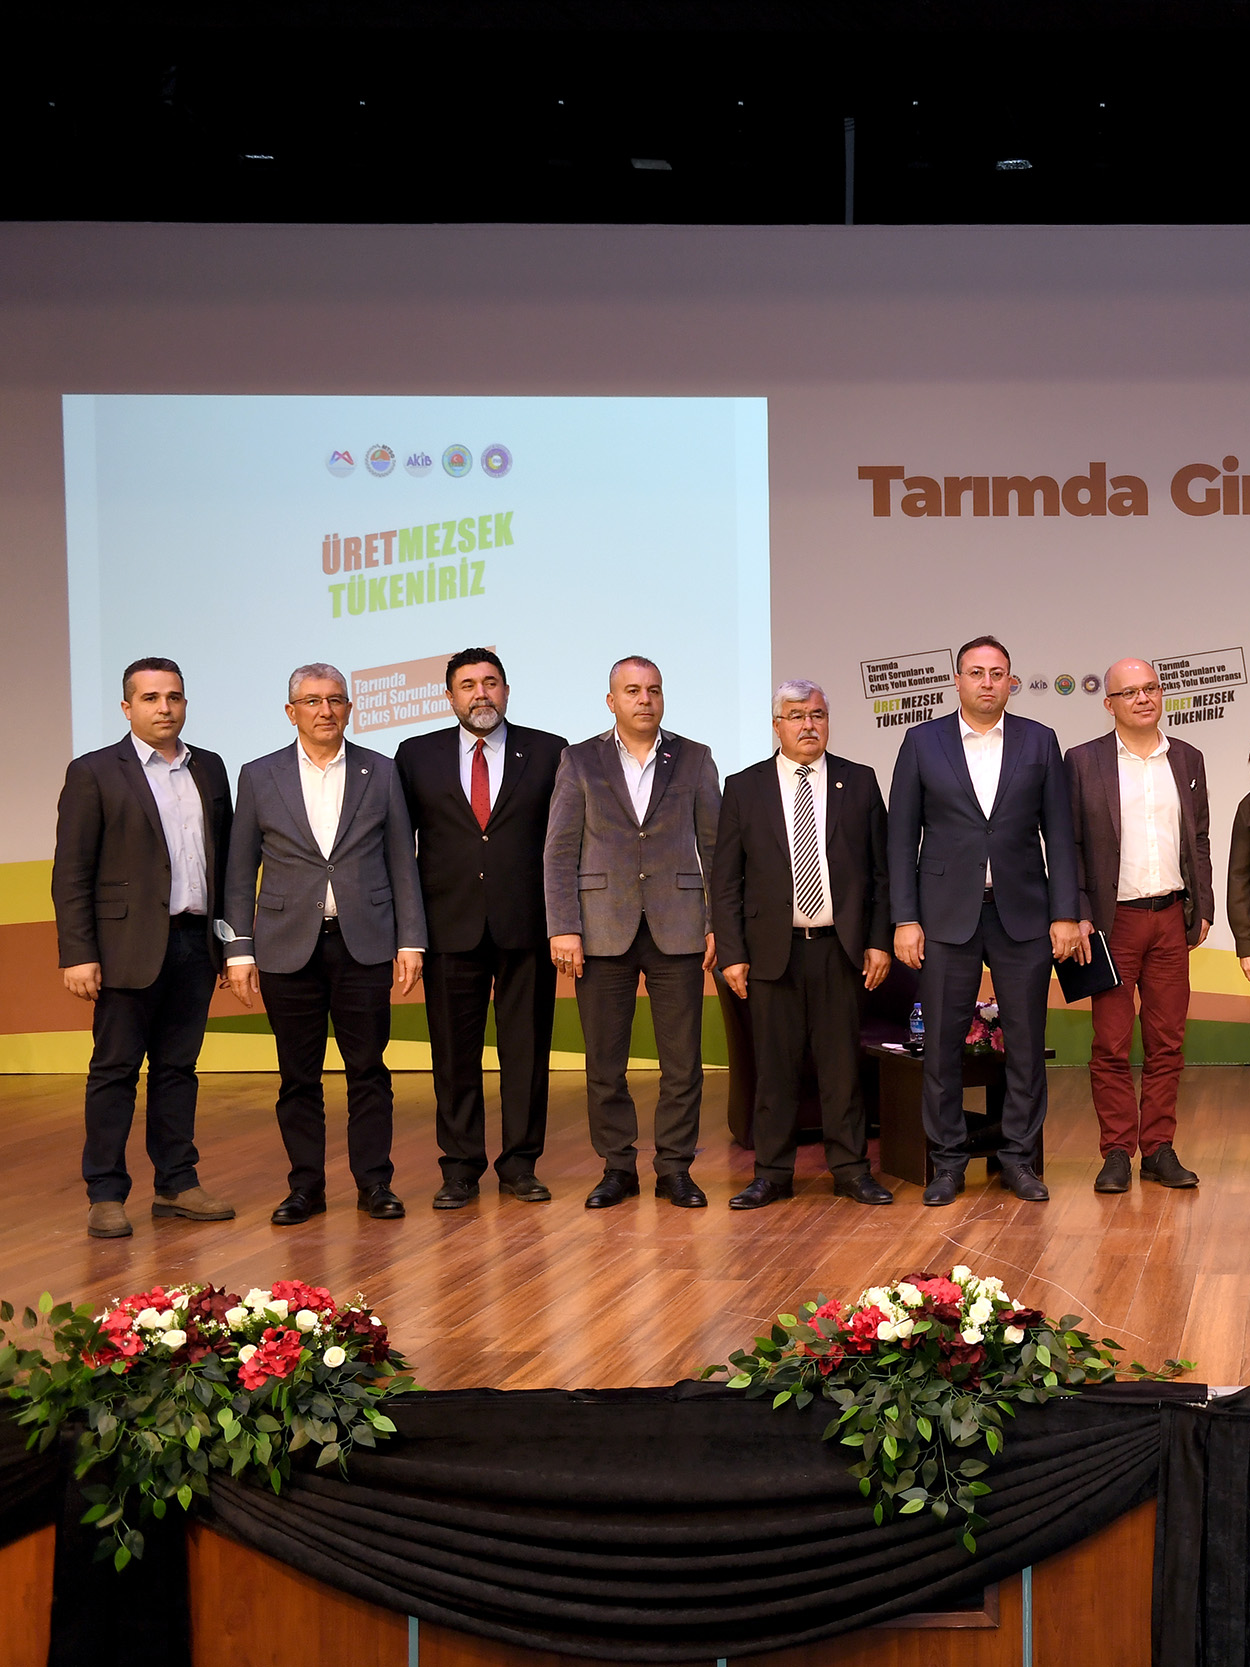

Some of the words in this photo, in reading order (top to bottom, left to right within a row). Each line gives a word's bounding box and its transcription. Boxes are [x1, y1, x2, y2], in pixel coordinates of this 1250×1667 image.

[858, 463, 1149, 517] Tarımda
[322, 511, 514, 575] ÜRETMEZSEK
[328, 557, 486, 618] TÜKENİRİZ
[866, 661, 898, 673] Tarımda
[868, 672, 887, 683] Girdi
[889, 668, 924, 680] Sorunları
[926, 666, 935, 674] ve
[1158, 660, 1190, 671] Tarımda
[1160, 670, 1178, 681] Girdi
[1180, 666, 1215, 678] Sorunları
[1217, 664, 1226, 672] ve
[354, 672, 406, 694] Tarımda
[870, 683, 889, 694] Çıkış
[890, 680, 907, 689] Yolu
[908, 674, 950, 687] Konferansı
[1161, 681, 1181, 692] Çıkış
[1182, 678, 1198, 688] Yolu
[1200, 672, 1241, 685] Konferansı
[356, 691, 387, 711] Girdi
[390, 682, 447, 705] Sorunlar
[873, 692, 944, 714] ÜRETMEZSEK
[1165, 690, 1235, 712] ÜRETMEZSEK
[359, 709, 390, 730] Çıkış
[393, 703, 420, 720] Yolu
[876, 707, 933, 728] TÜKENİRİZ
[1167, 706, 1225, 727] TÜKENİRİZ
